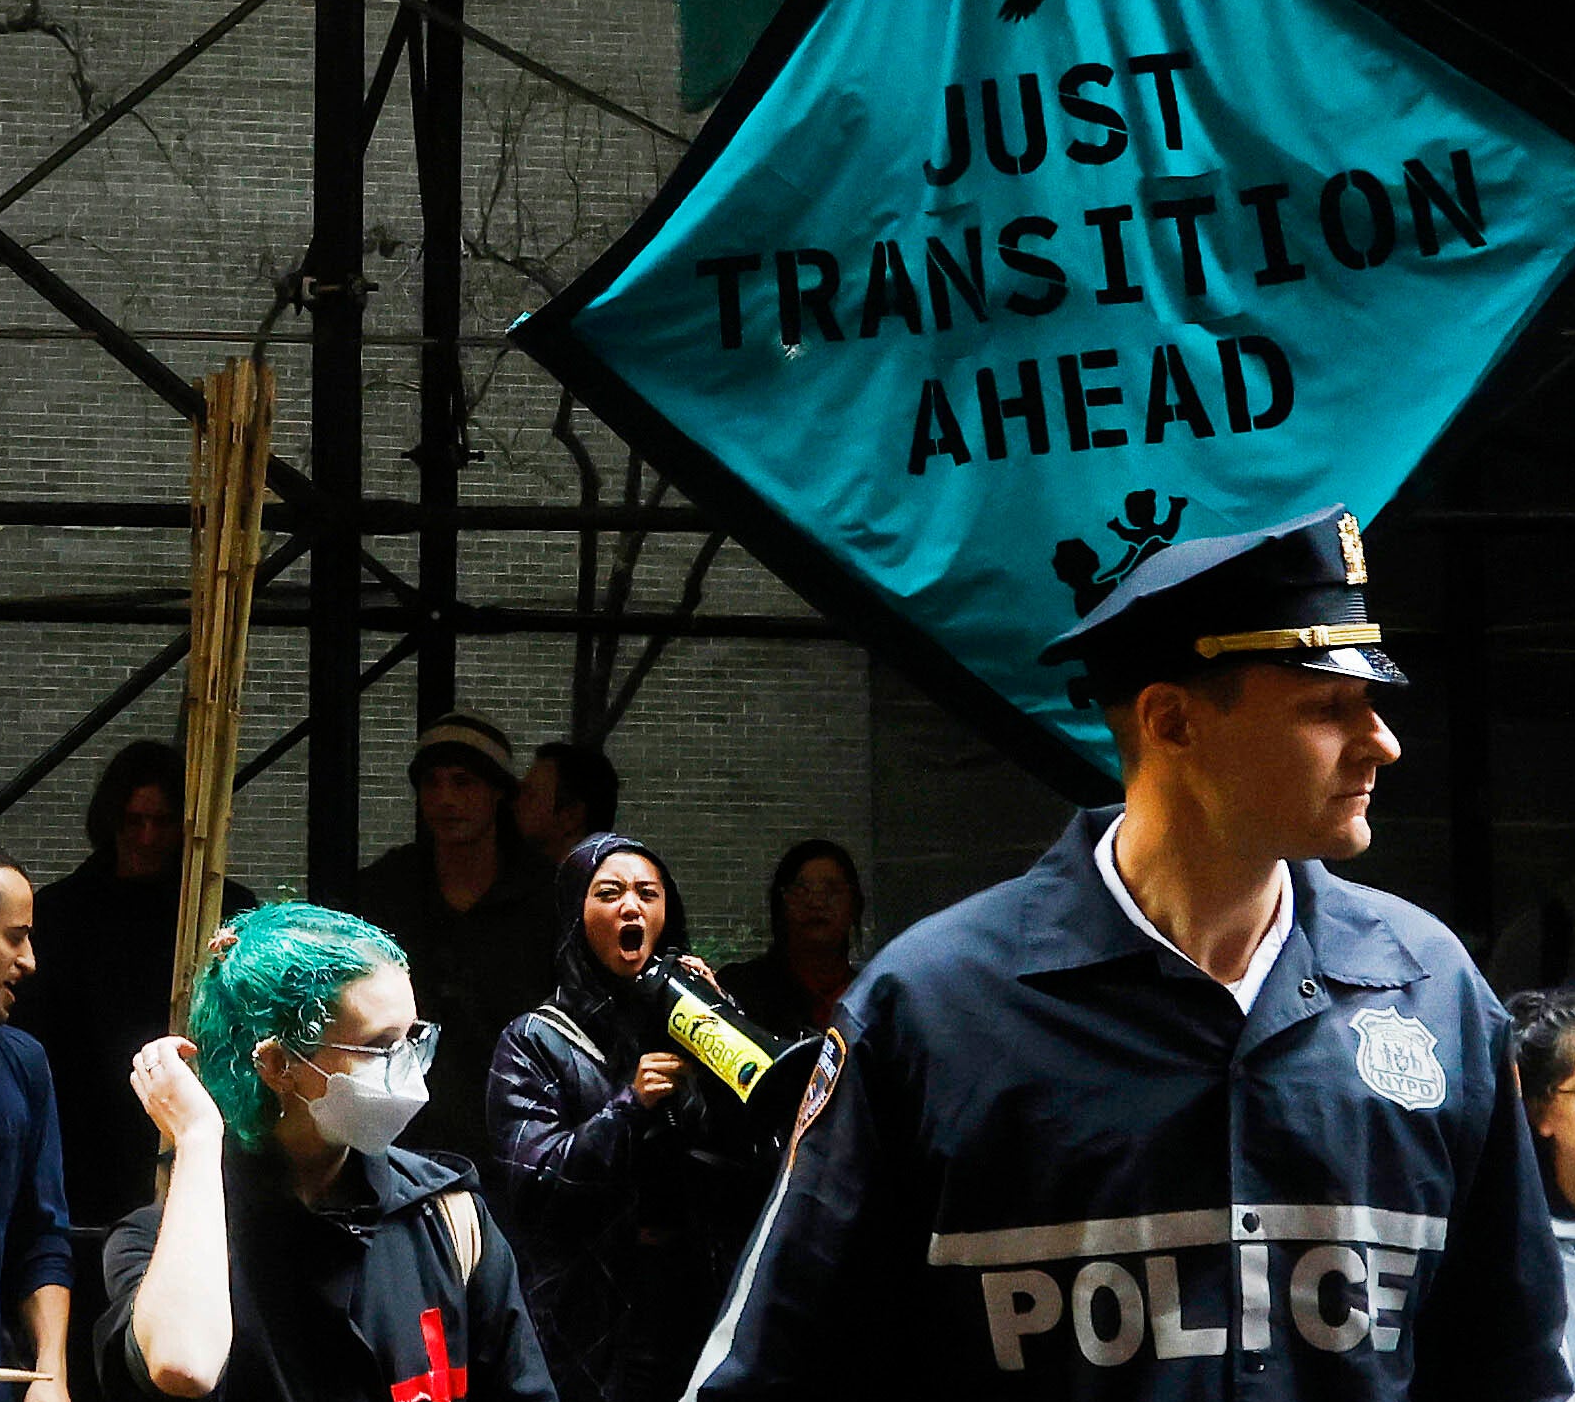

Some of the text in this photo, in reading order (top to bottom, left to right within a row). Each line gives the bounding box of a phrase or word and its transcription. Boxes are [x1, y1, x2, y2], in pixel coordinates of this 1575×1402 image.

[923, 52, 1195, 190] JUST
[696, 149, 1489, 351] TRANSITION
[908, 336, 1297, 477] AHEAD
[981, 1243, 1417, 1371] POLICE
